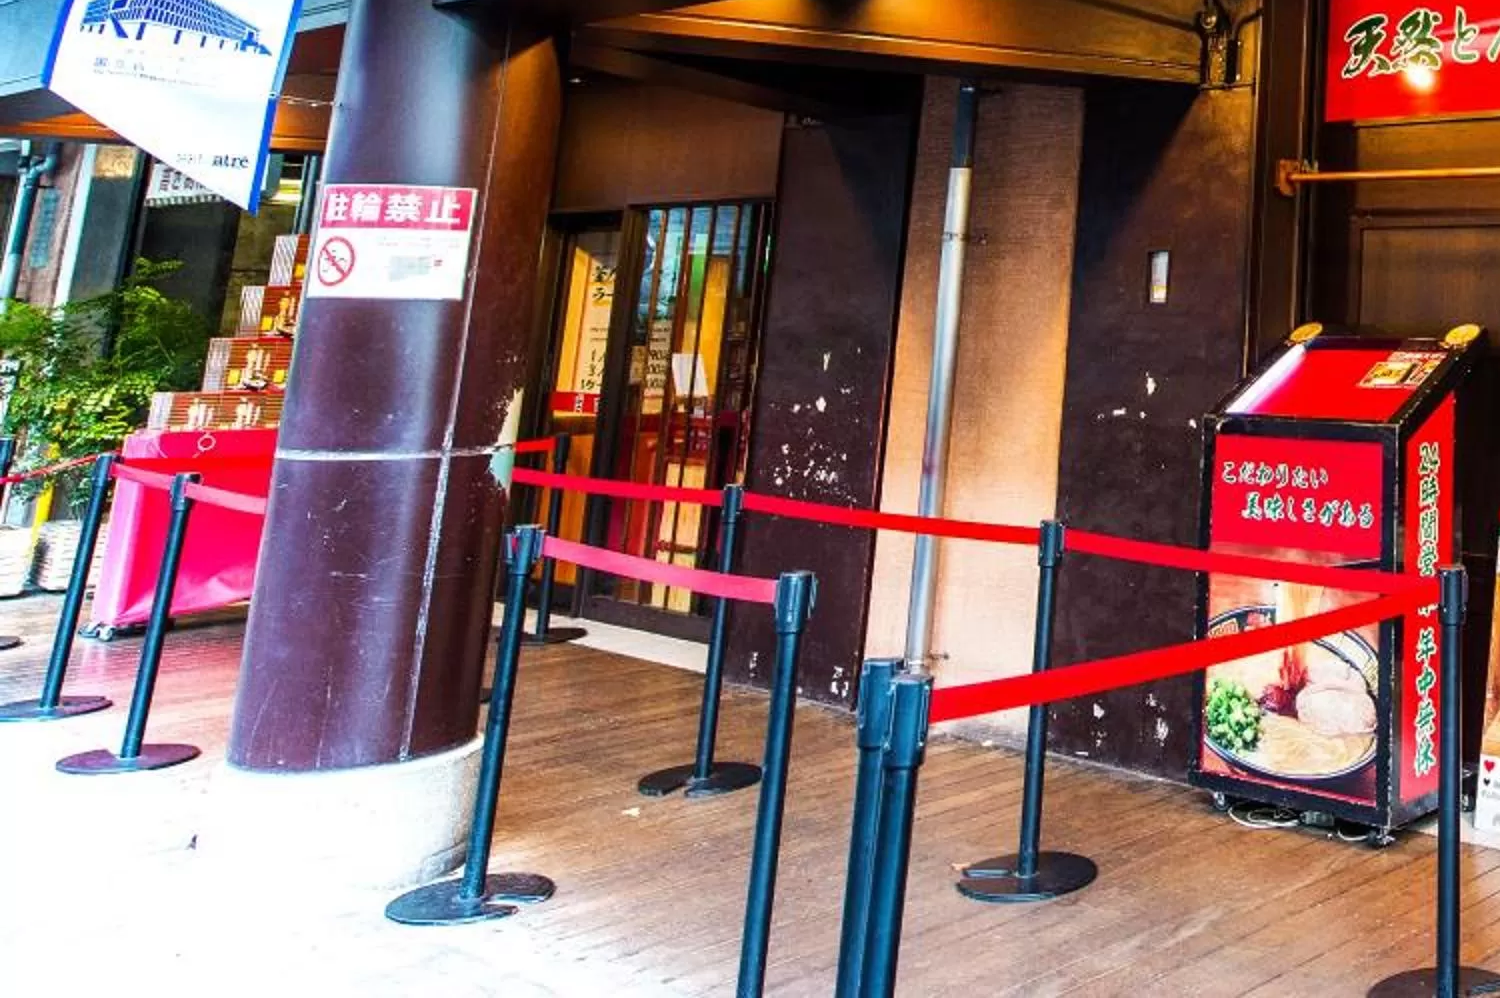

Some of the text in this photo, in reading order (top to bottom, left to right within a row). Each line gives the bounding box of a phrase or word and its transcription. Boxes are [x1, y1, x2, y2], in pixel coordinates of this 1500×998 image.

[325, 190, 461, 225] 駐輪禁止
[1222, 461, 1329, 489] こだわりたい
[1241, 491, 1375, 529] 美味しさがある
